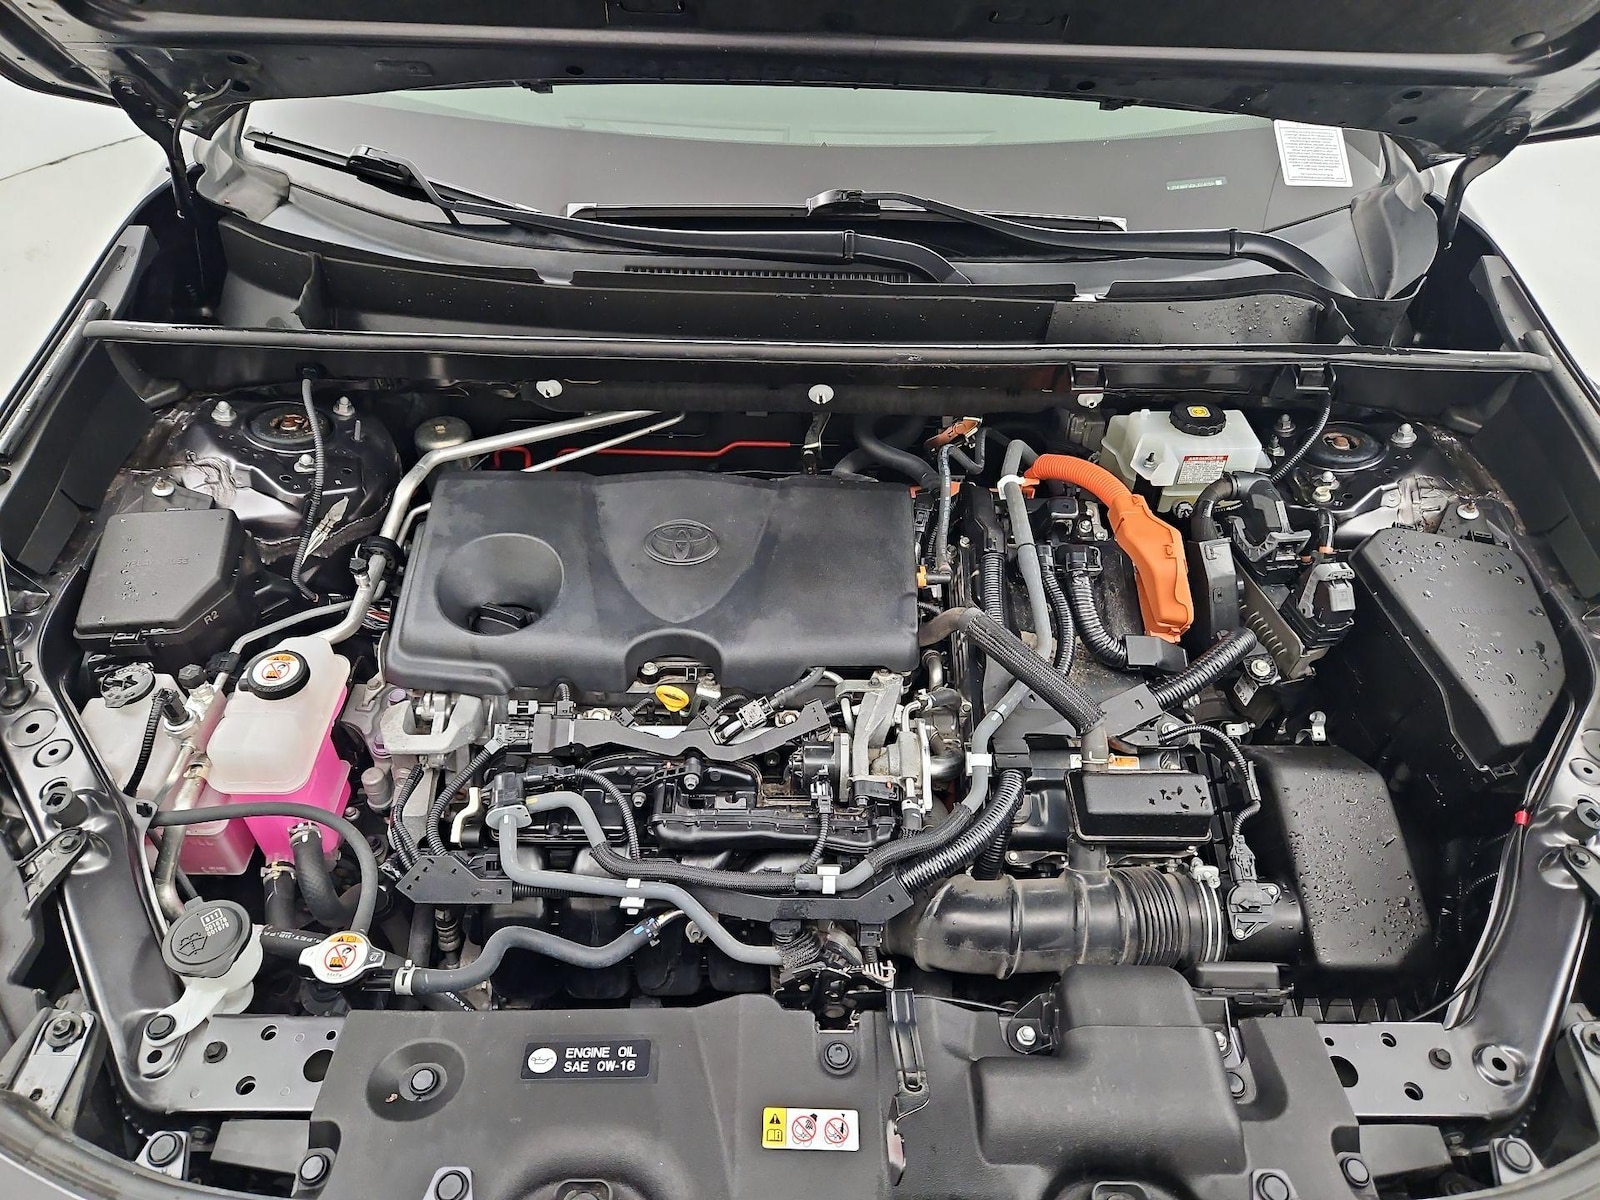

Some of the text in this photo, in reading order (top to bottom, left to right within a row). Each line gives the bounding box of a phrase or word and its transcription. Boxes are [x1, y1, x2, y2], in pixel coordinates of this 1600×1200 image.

[203, 610, 220, 625] R2
[565, 1046, 638, 1059] ENGINE OIL
[563, 1060, 636, 1073] SAE 0W-16
